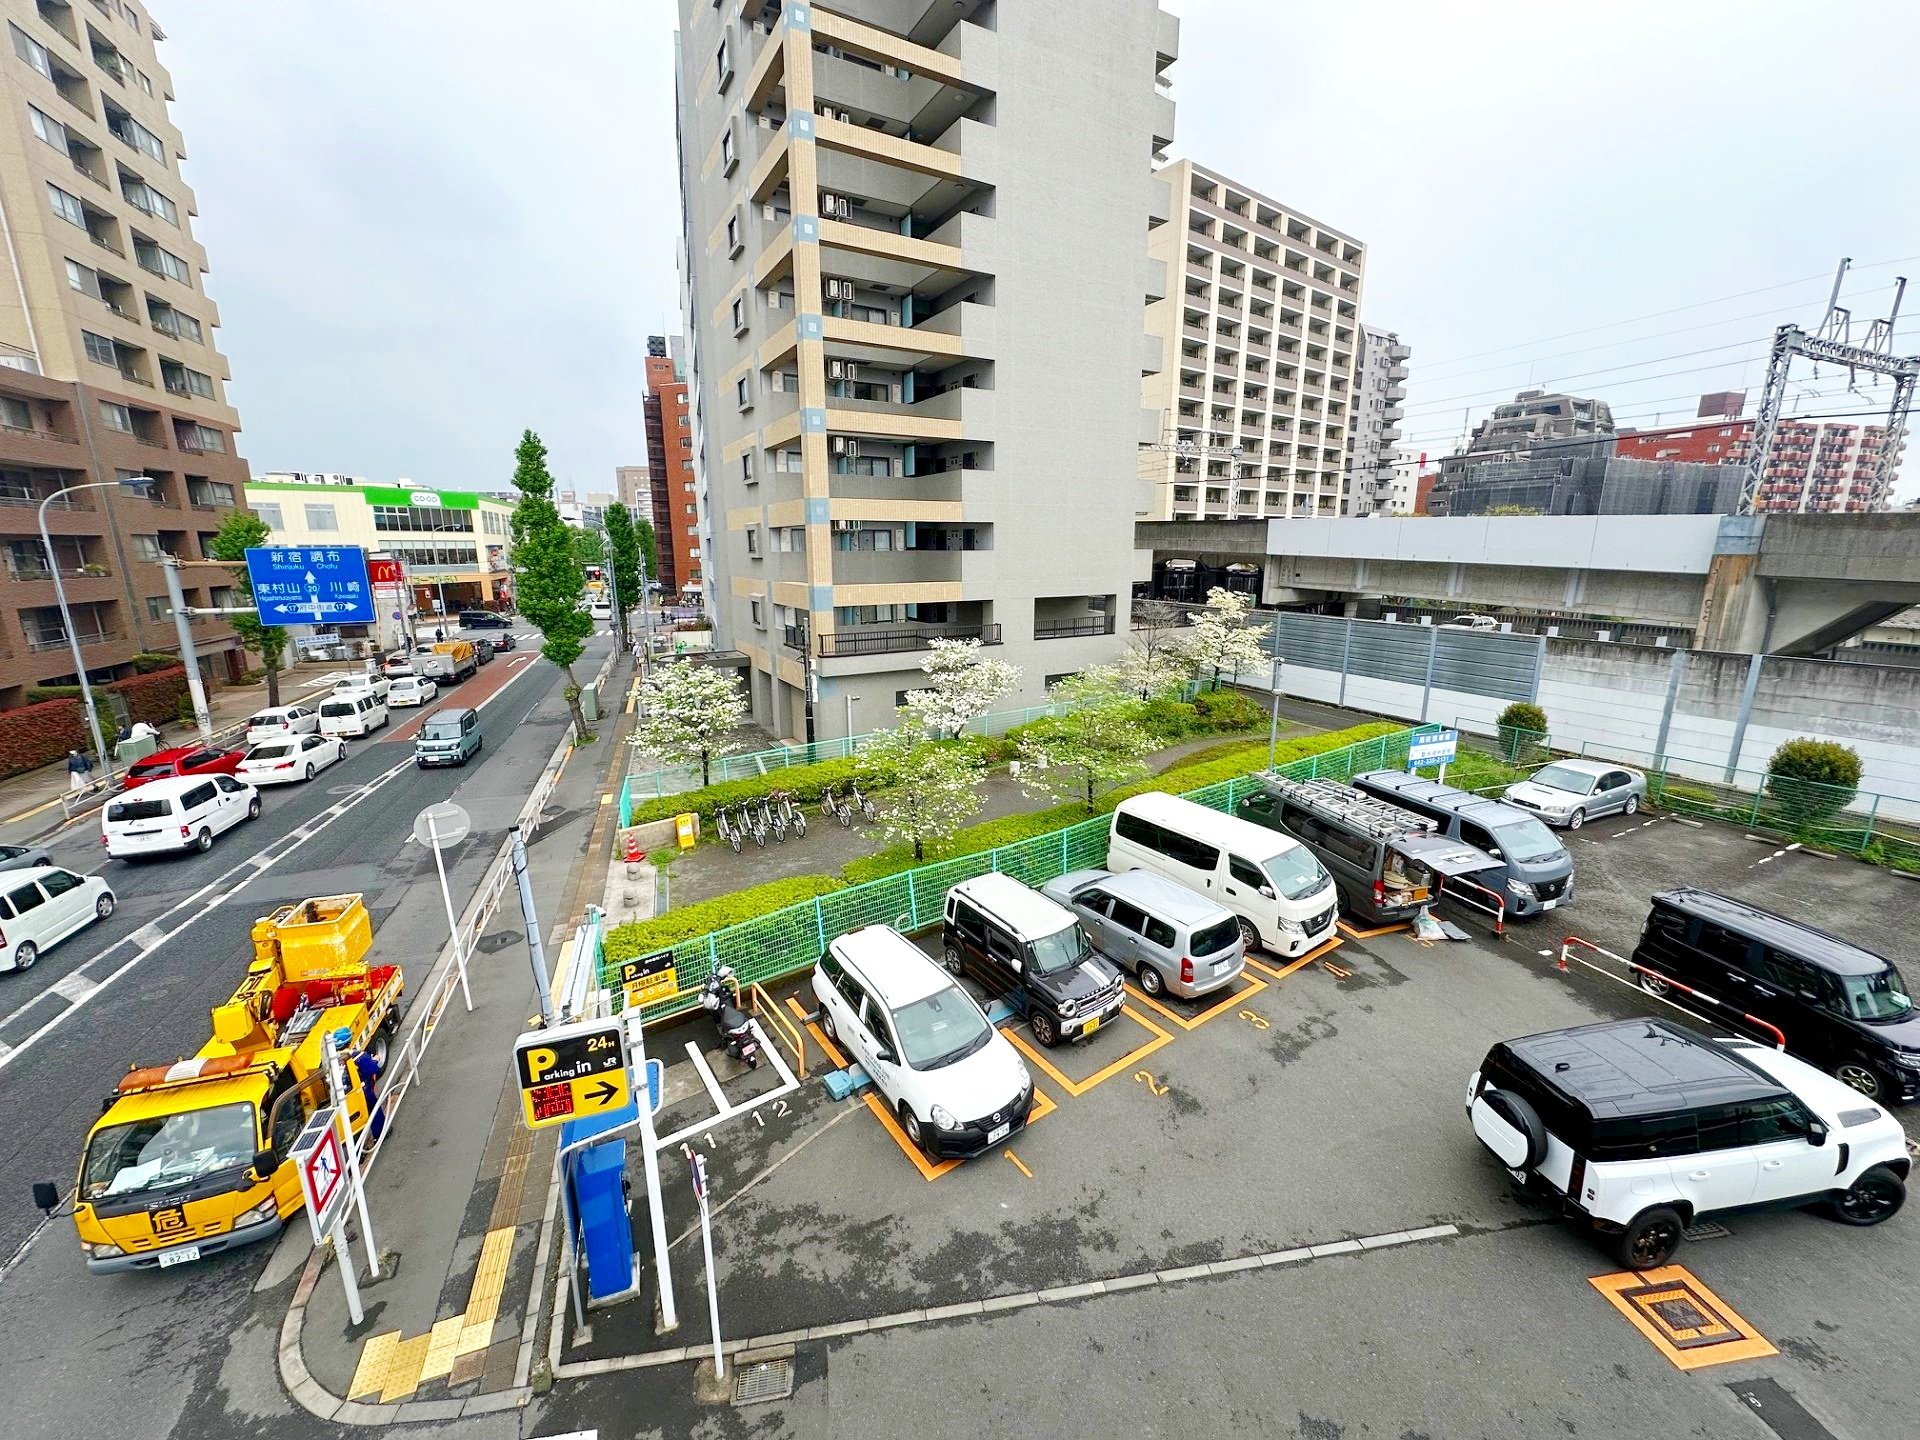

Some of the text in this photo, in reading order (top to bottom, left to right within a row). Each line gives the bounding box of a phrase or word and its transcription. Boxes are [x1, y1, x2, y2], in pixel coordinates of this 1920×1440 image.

[270, 551, 340, 563] 新宿 調布
[257, 582, 300, 595] 東村山
[329, 581, 360, 593] 川崎
[288, 604, 297, 612] 17
[335, 603, 344, 611] 17
[1239, 1010, 1270, 1030] 3
[575, 1060, 592, 1075] in
[1134, 1070, 1170, 1096] 2
[152, 1208, 185, 1233] 危
